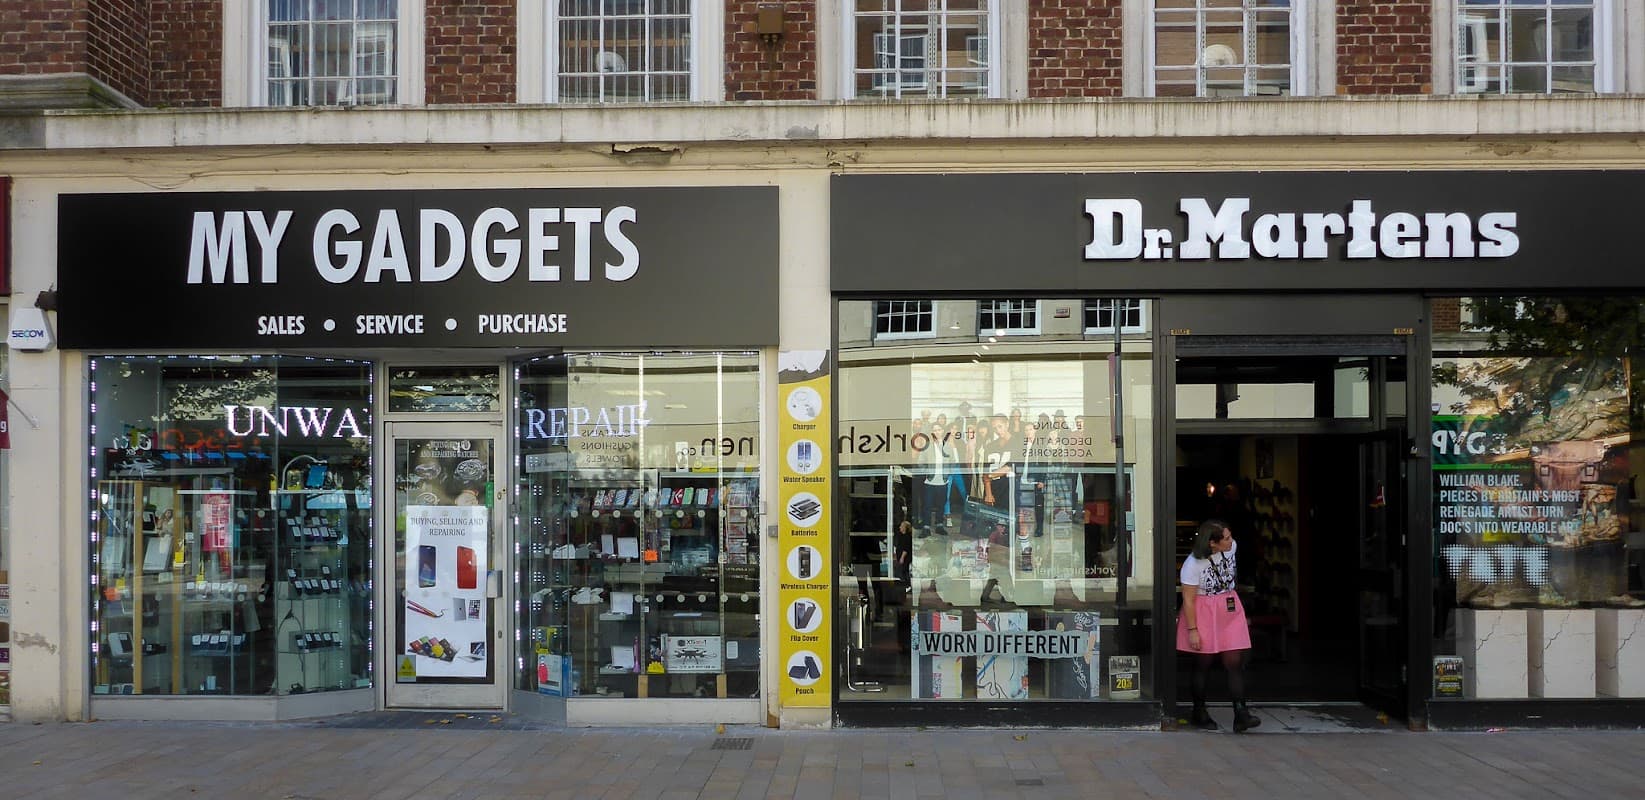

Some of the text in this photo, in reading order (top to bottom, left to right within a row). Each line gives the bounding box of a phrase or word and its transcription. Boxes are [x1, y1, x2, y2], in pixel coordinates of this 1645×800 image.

[1084, 197, 1519, 260] Dr. Martens
[186, 205, 640, 284] MY GADGETS
[257, 312, 567, 336] SALES SERVICE PURCHASE
[11, 329, 44, 338] SECOM
[224, 404, 371, 438] UNWA
[1439, 474, 1524, 487] WILLIAM BLAKE.
[1439, 490, 1581, 503] PIECES BY BRITAIN'S MOST
[1439, 505, 1564, 519] RENEGADE ARTIST TURN
[440, 517, 468, 526] SELLING
[469, 517, 484, 526] AND
[1439, 521, 1472, 534] DOC'S
[1474, 521, 1500, 534] INTO
[1501, 521, 1557, 534] WEARABLE
[429, 528, 465, 536] REPAIRING
[791, 528, 818, 537] Batteries
[780, 582, 829, 591] Wireless Charger
[802, 634, 819, 642] Cover
[924, 633, 1081, 655] WORN DIFFERENT
[795, 687, 815, 695] Pouch
